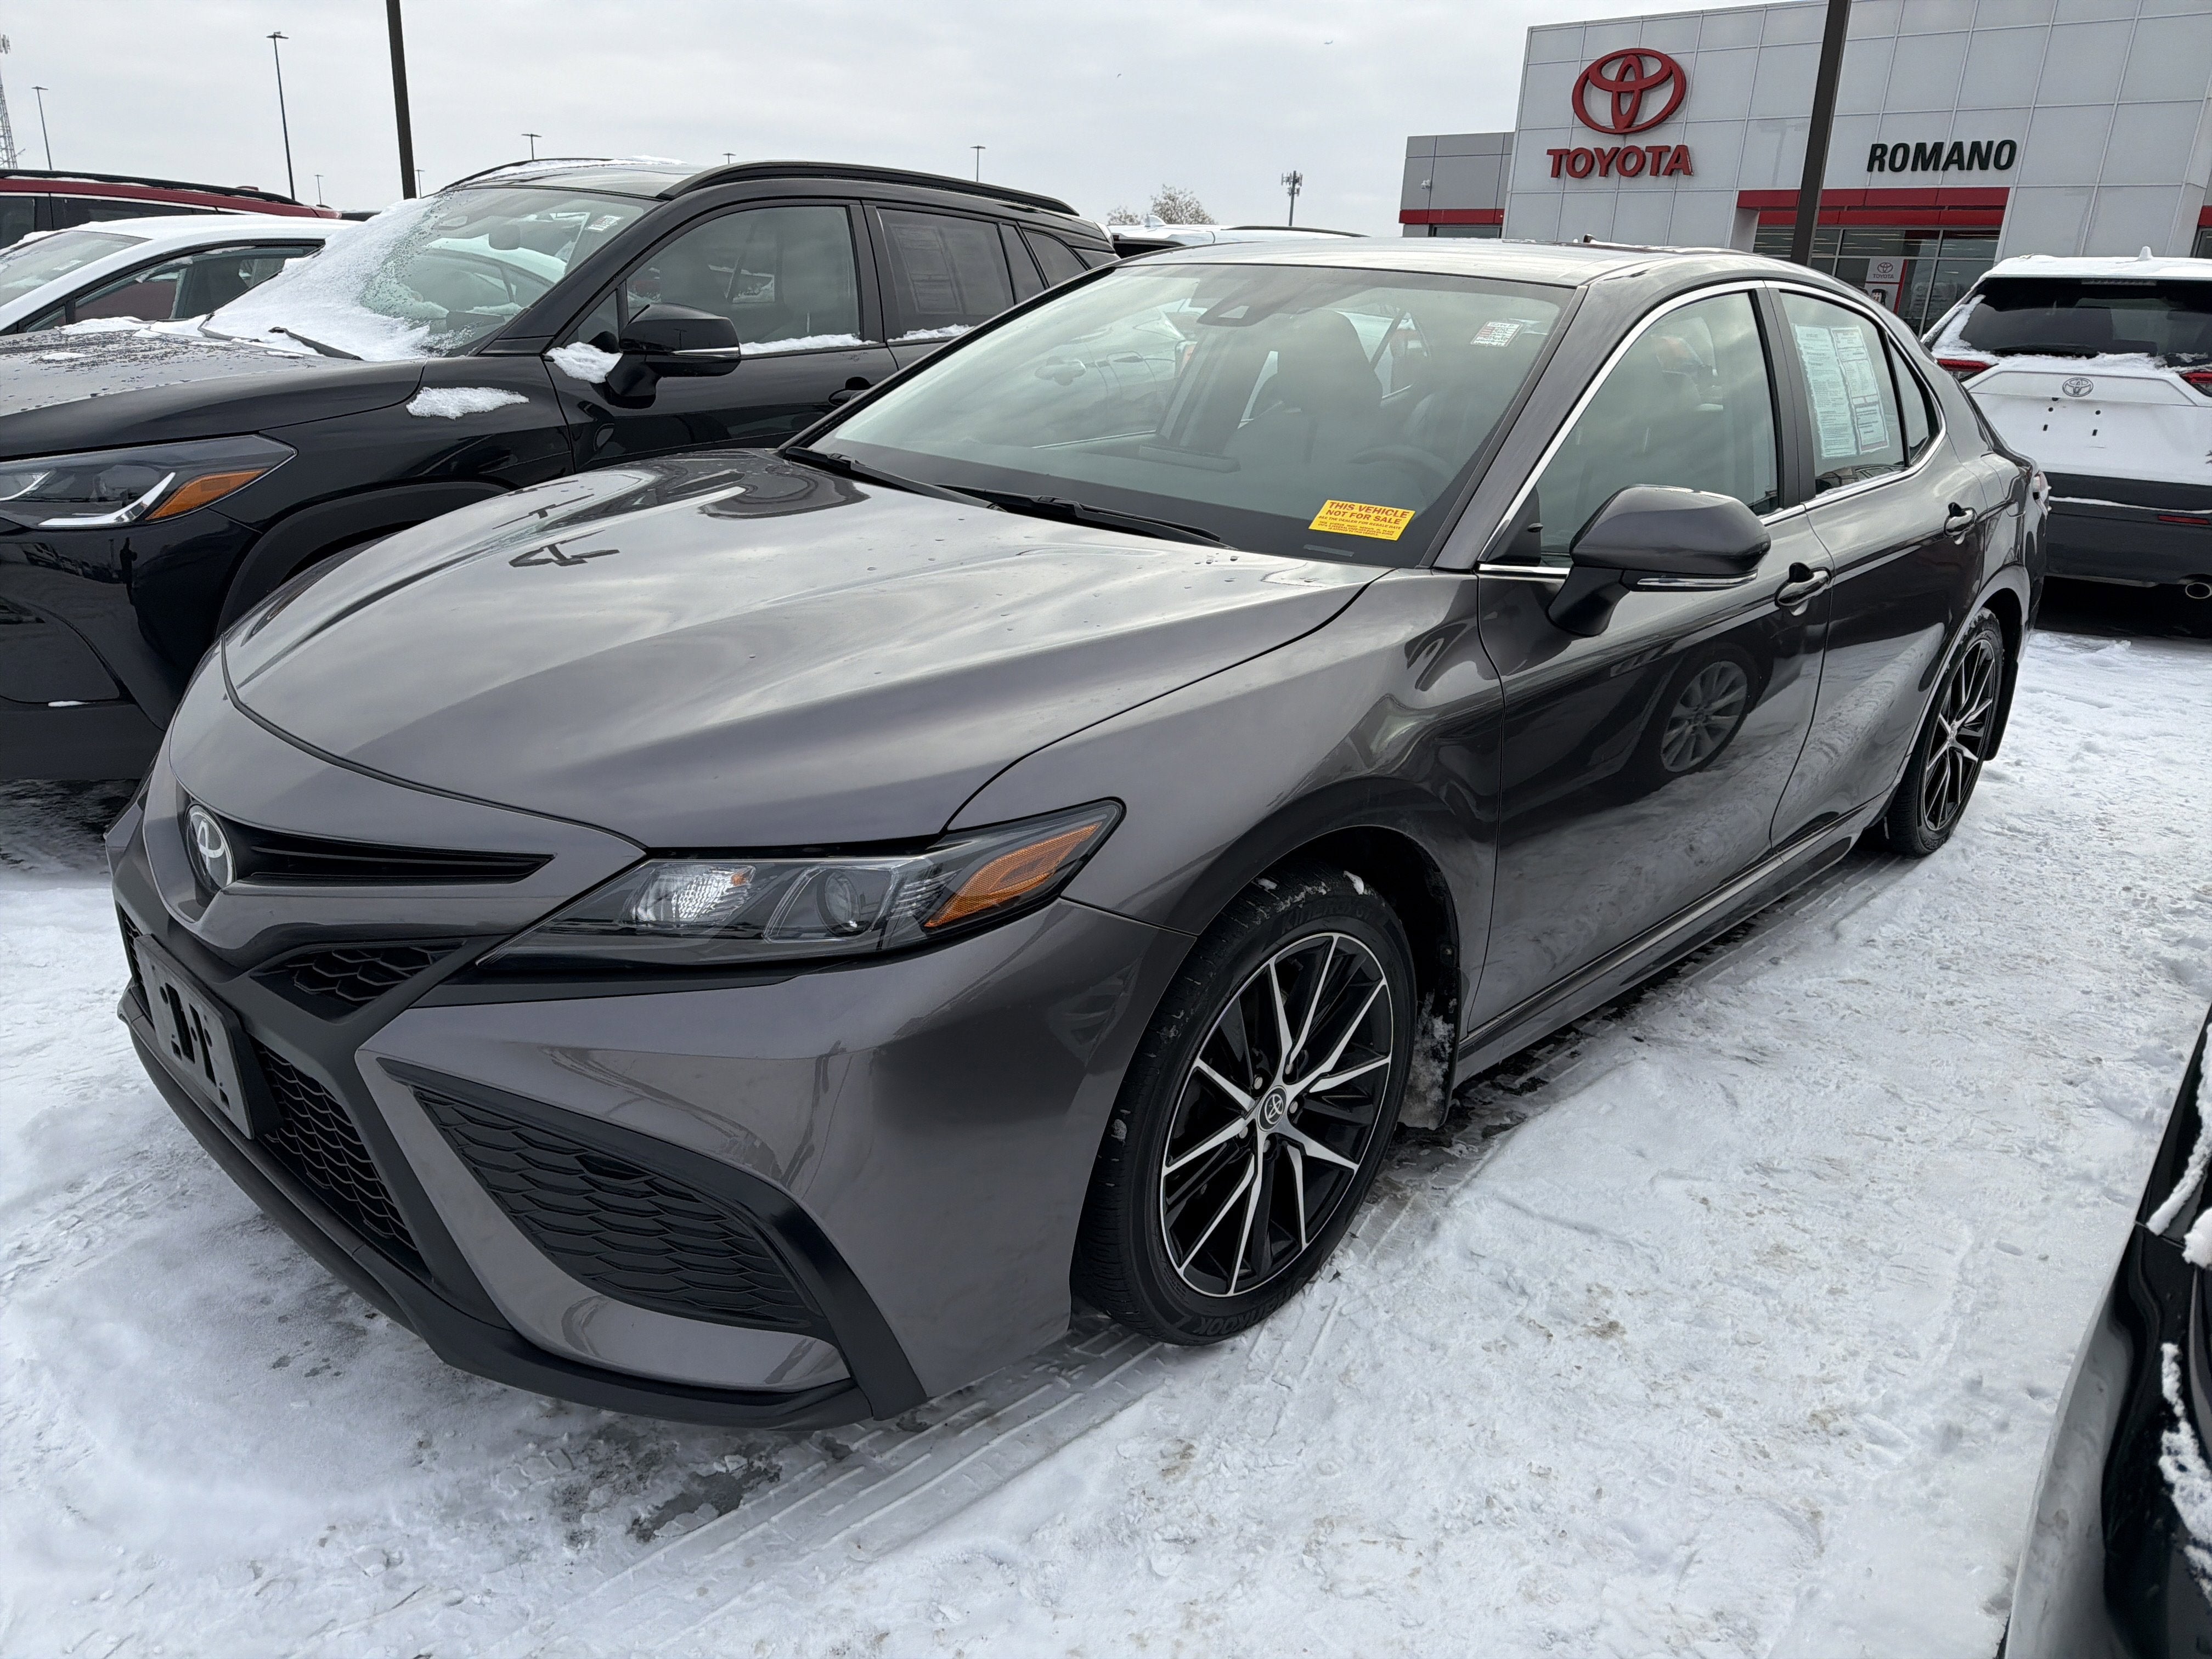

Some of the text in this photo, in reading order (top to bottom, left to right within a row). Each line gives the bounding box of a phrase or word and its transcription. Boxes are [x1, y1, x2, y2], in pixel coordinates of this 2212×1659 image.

[1547, 144, 1694, 179] TOYOTA
[1866, 139, 2017, 172] ROMANO
[1329, 501, 1410, 518] THIS VEHICLE
[1373, 516, 1402, 524] SALE
